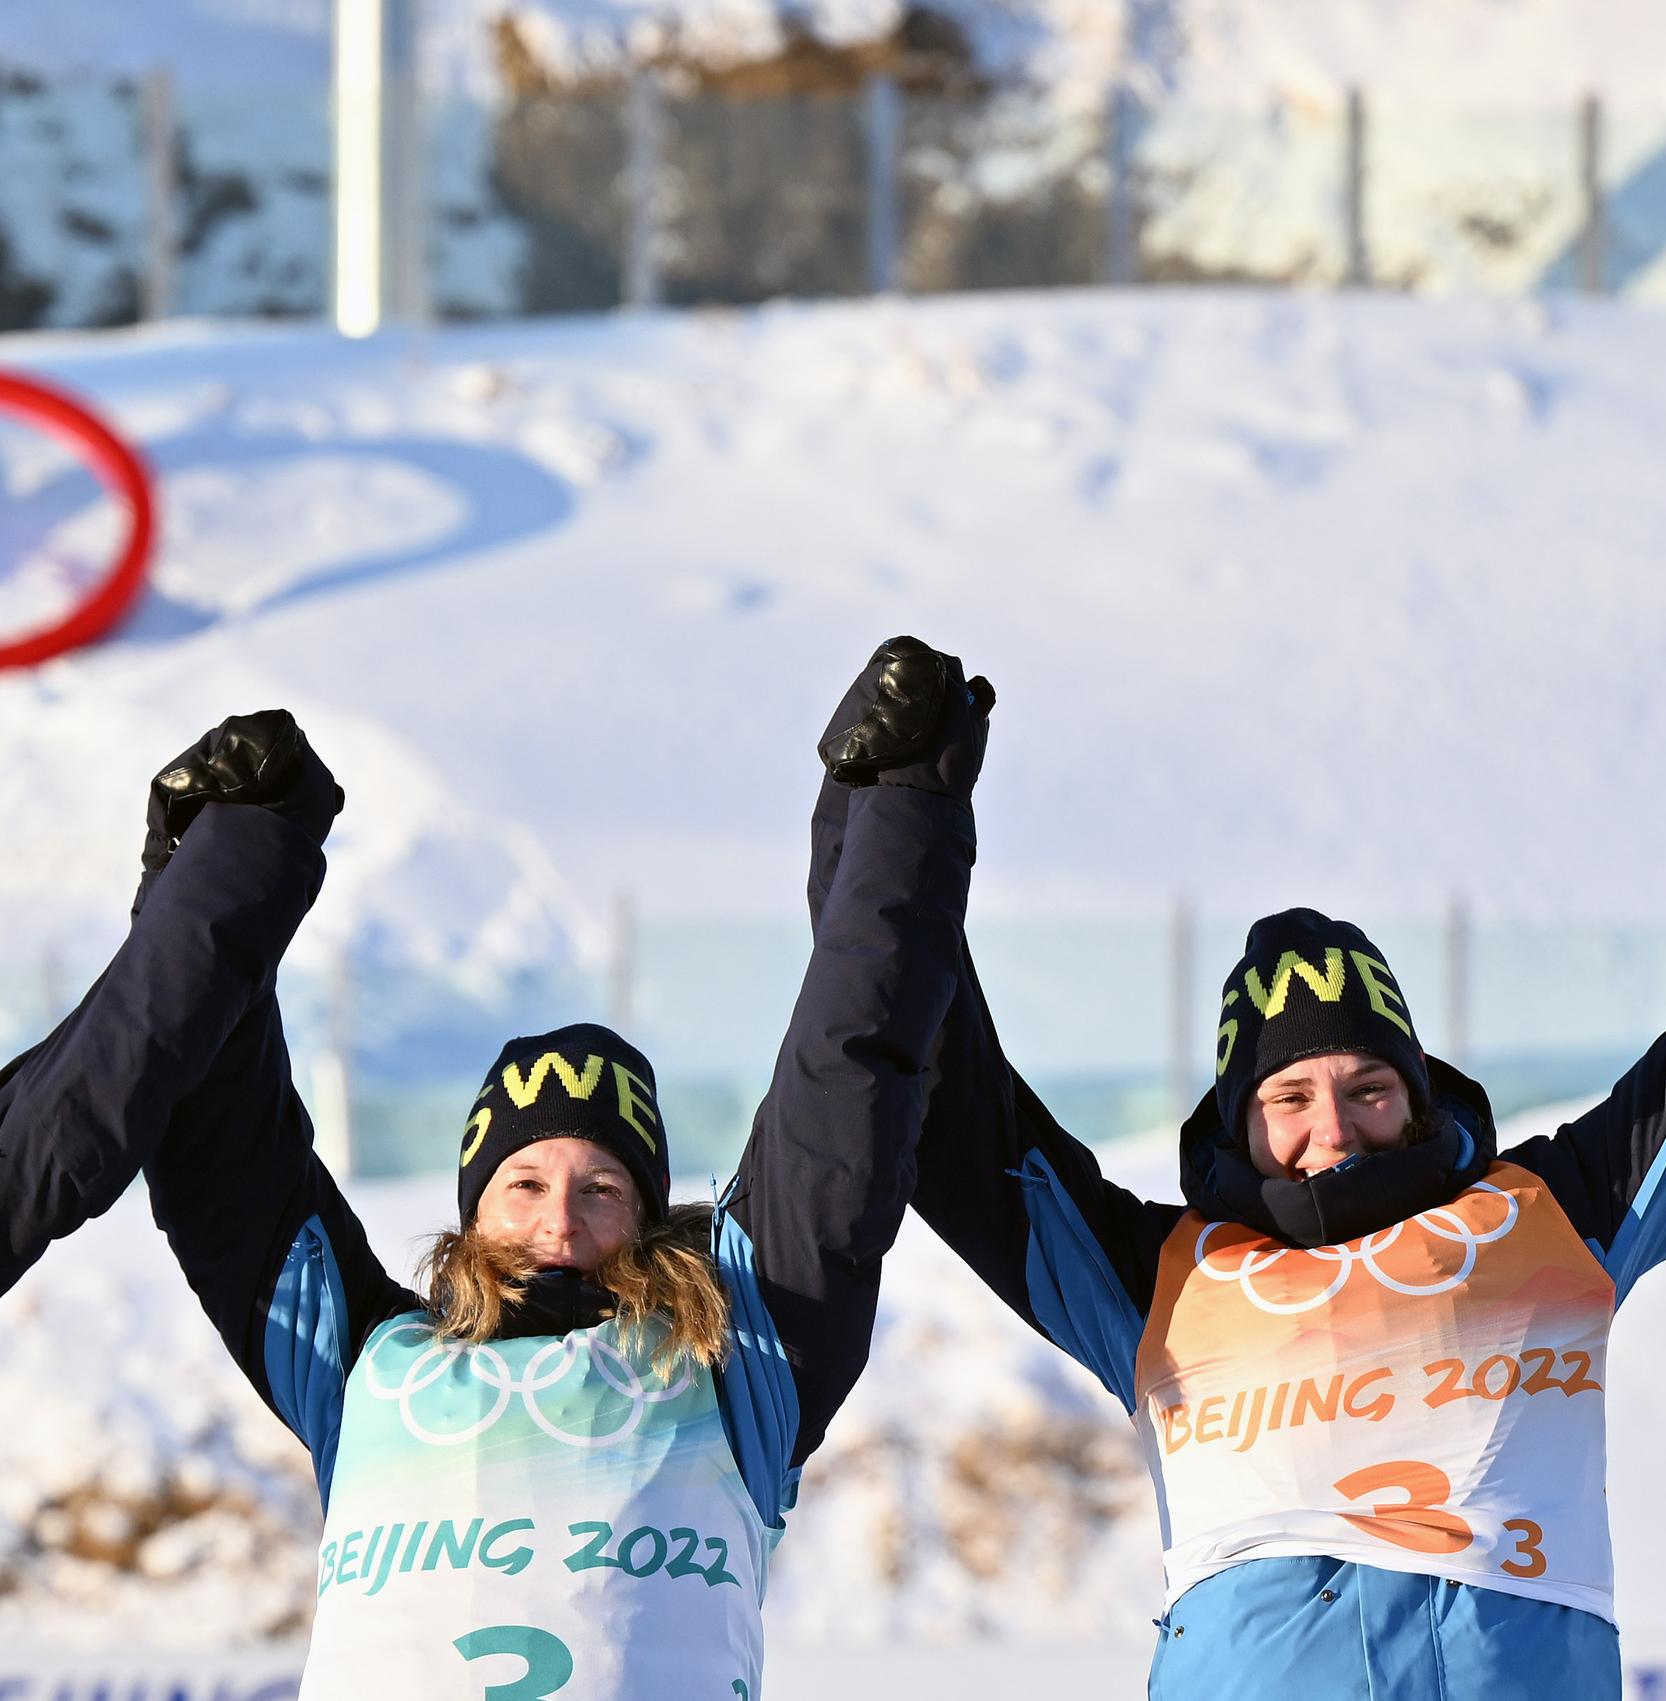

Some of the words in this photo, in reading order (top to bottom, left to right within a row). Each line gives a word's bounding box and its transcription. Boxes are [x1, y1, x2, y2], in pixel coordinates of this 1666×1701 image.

[1160, 1367, 1395, 1455] BEIJING
[1422, 1348, 1604, 1410] 2022
[1332, 1460, 1475, 1554] 3
[1500, 1519, 1547, 1578] 3
[319, 1518, 536, 1598] BEIJING
[563, 1521, 743, 1589] 2022
